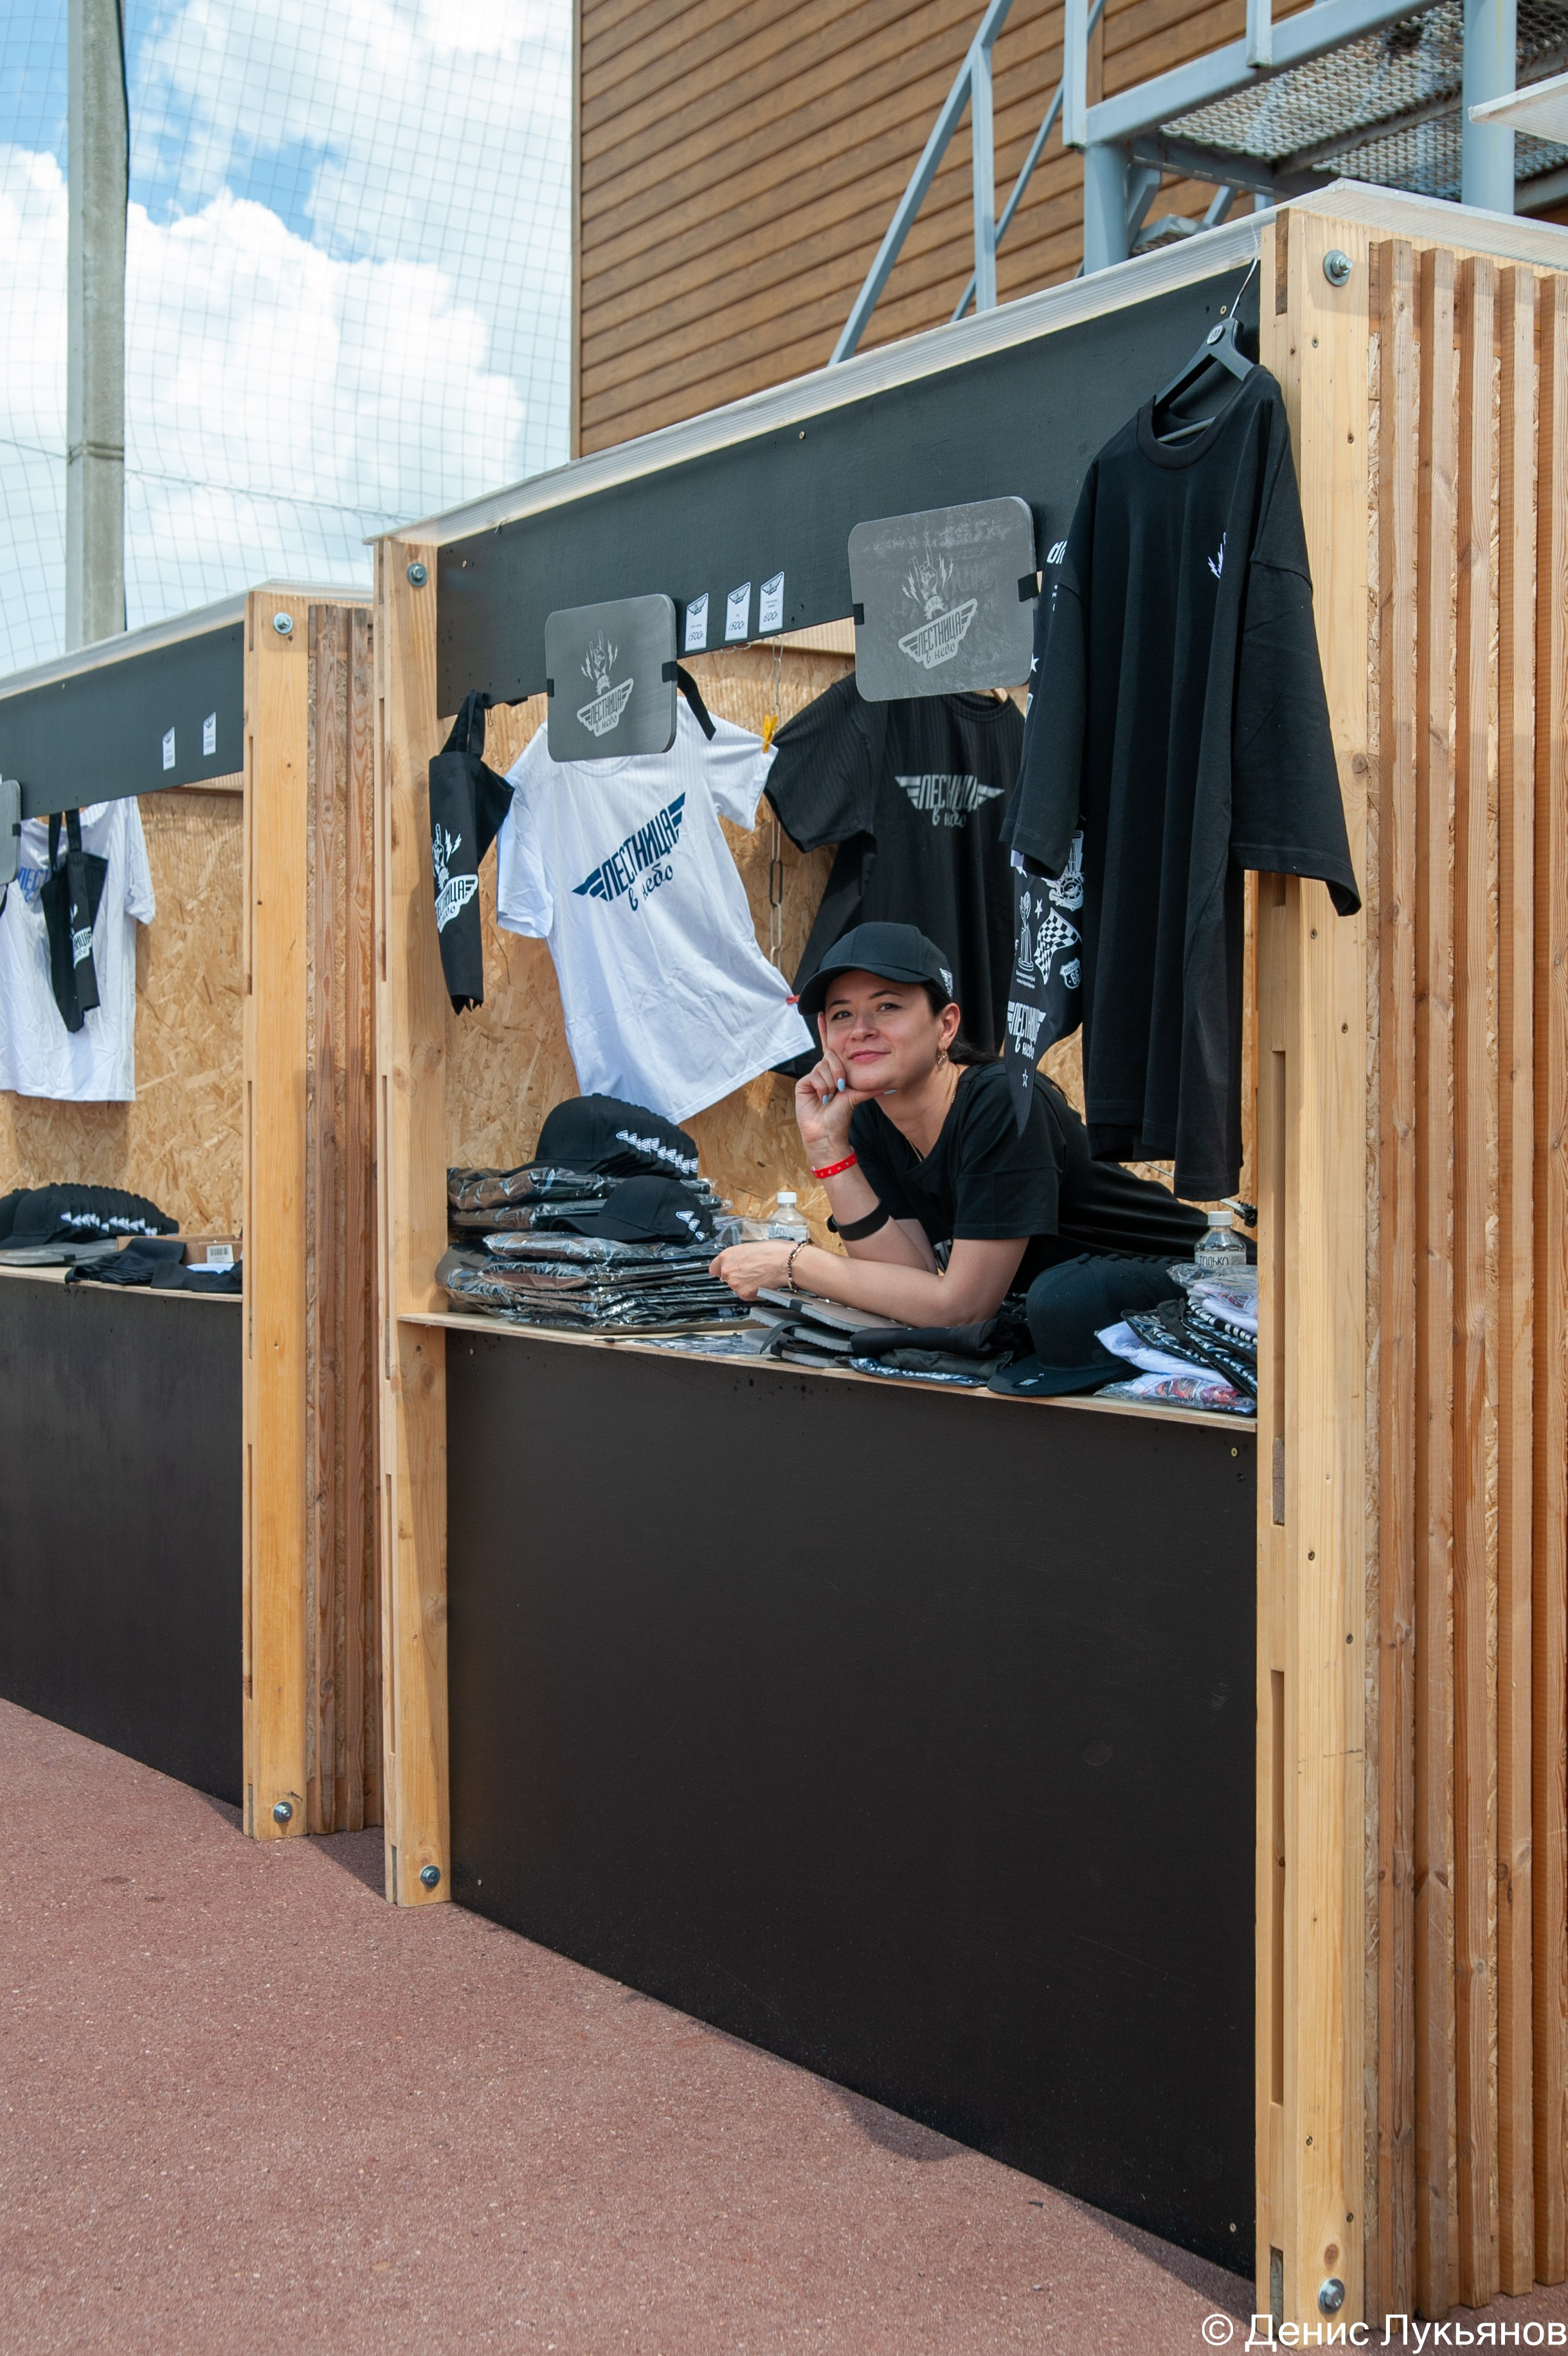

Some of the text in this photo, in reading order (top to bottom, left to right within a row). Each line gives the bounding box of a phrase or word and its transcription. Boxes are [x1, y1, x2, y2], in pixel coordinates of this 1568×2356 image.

[918, 610, 962, 656] ЛЕСТНИЦА
[590, 688, 622, 726] ЛЕСТНИЦА
[601, 808, 677, 901] ЛЕСТНИЦА
[628, 862, 673, 912] в небо
